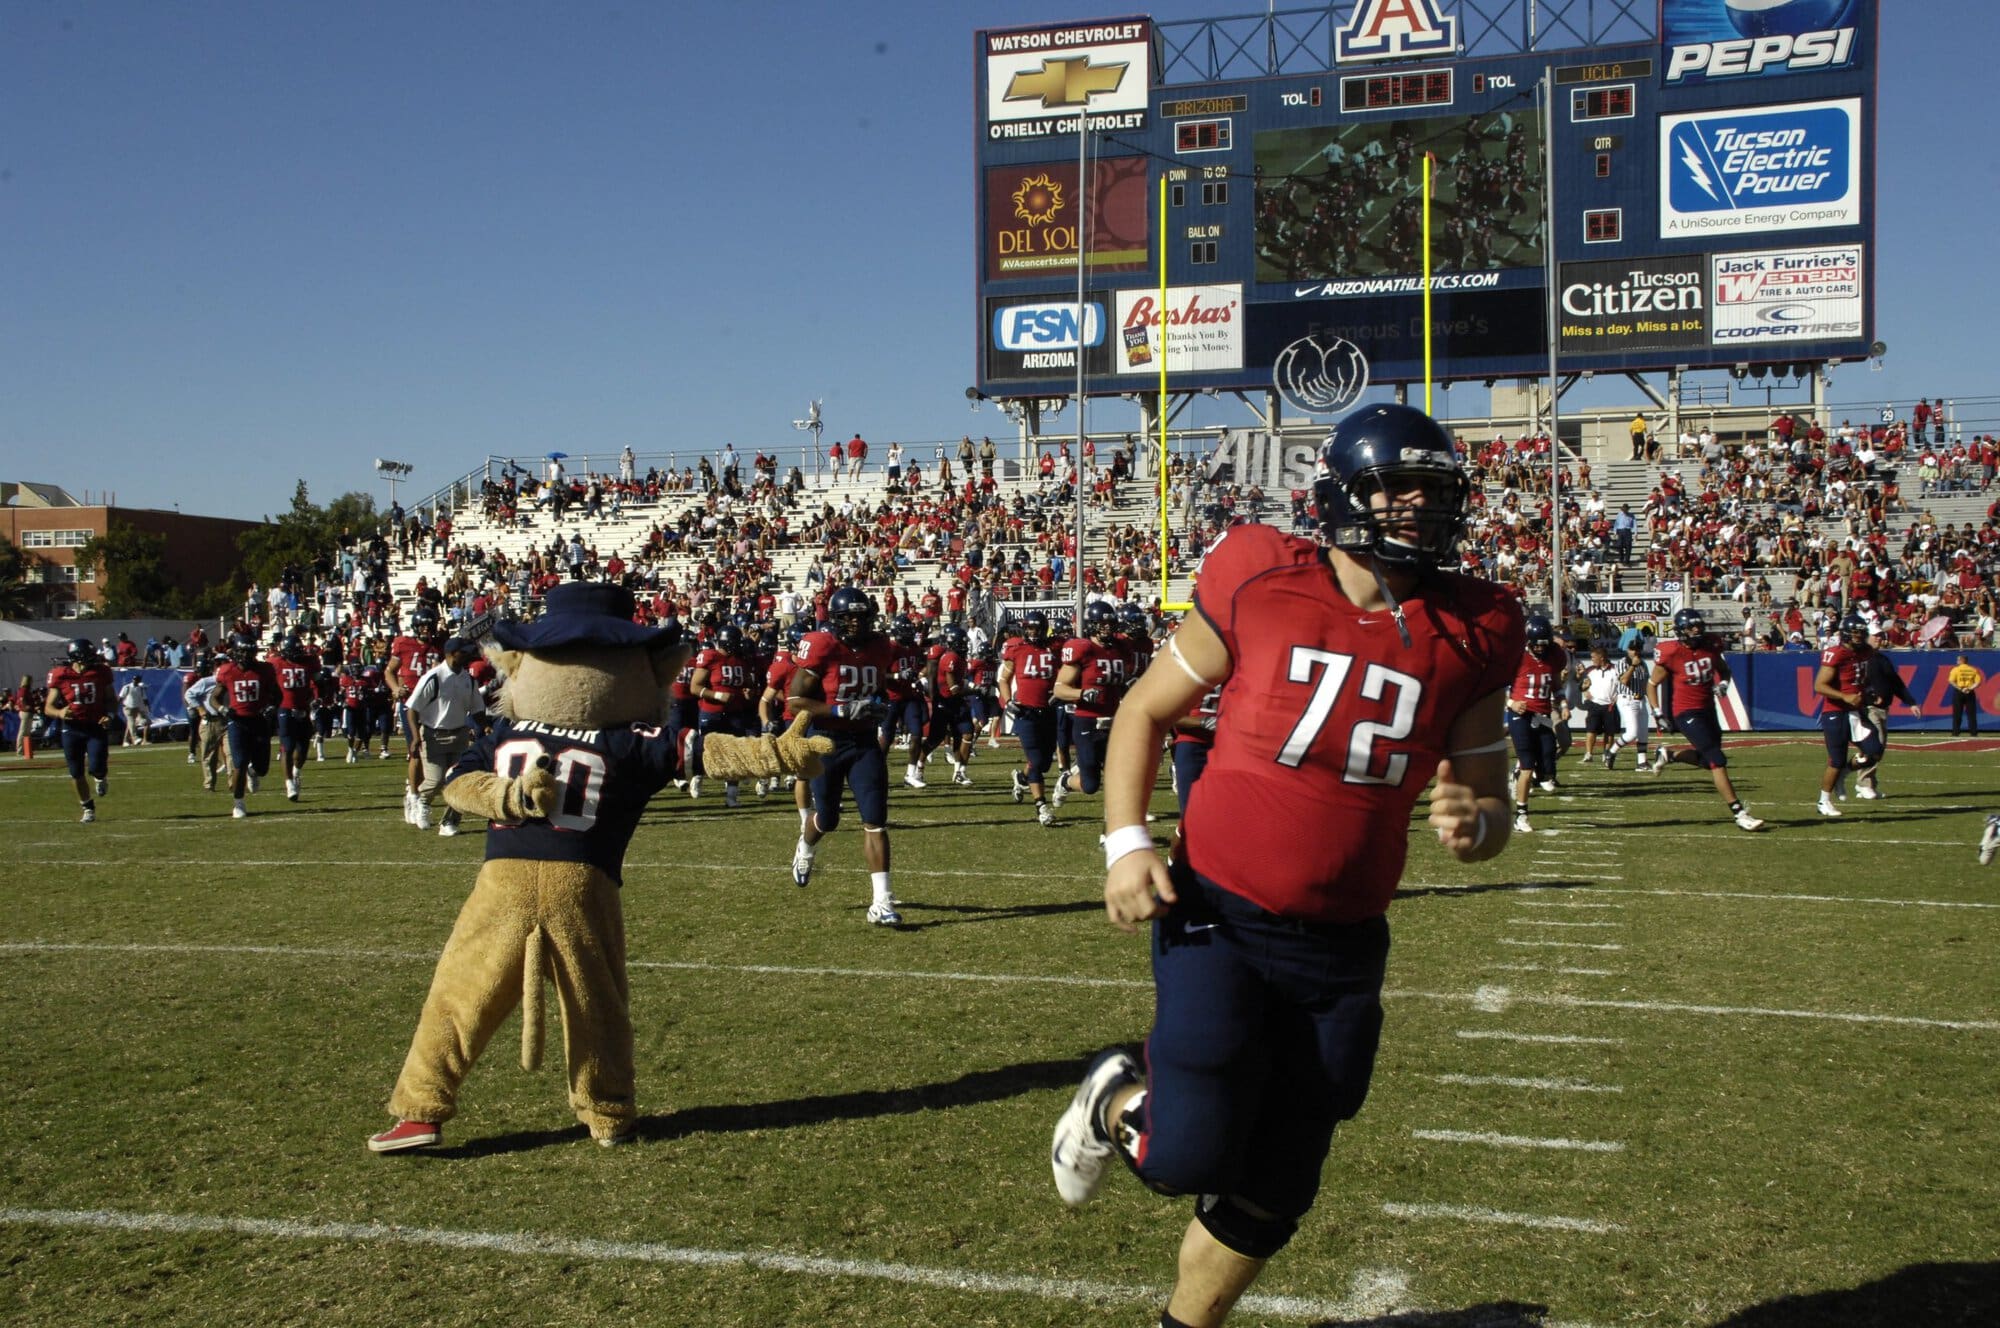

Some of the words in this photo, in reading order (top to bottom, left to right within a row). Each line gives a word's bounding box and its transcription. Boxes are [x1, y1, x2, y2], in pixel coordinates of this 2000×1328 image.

[991, 33, 1050, 50] WATSON
[1054, 24, 1142, 45] CHEVROLET
[1666, 27, 1855, 82] PEPSI
[1487, 75, 1516, 88] TOL
[1582, 64, 1622, 82] UCLA
[1175, 98, 1233, 116] ARIZONA
[1281, 94, 1308, 106] TOL
[990, 120, 1055, 138] O'RIELLY
[1594, 137, 1612, 150] QTR
[1714, 127, 1806, 153] Tucson
[1722, 145, 1832, 174] Electric
[1169, 169, 1187, 181] DWN
[1203, 167, 1213, 179] TO
[1215, 166, 1227, 178] GO
[1733, 172, 1831, 196] Power
[1668, 219, 1678, 230] A
[1681, 216, 1741, 230] UniSource
[1744, 213, 1786, 226] Energy
[1789, 208, 1848, 223] Company
[999, 229, 1035, 254] DEL
[1043, 226, 1079, 251] SOL
[1188, 226, 1207, 238] BALL
[1208, 225, 1220, 237] ON
[1003, 256, 1079, 269] AVAconcerts.com
[1719, 259, 1765, 274] Jack
[1773, 253, 1856, 269] Furrier's
[1628, 271, 1700, 287] Tucson
[1562, 280, 1703, 316] Citizen
[1760, 288, 1782, 296] TIRE
[1785, 287, 1791, 295] &
[1795, 286, 1823, 294] AUTO
[1826, 284, 1853, 293] CARE
[1123, 295, 1237, 328] Bashas'
[1011, 308, 1088, 344] FSN
[1199, 331, 1215, 340] You
[1217, 330, 1229, 340] By
[1308, 321, 1400, 340] Famous
[1562, 325, 1592, 336] Miss
[1595, 327, 1604, 335] a
[1607, 323, 1632, 336] day.
[1636, 321, 1667, 333] Miss
[1670, 322, 1679, 330] a
[1682, 320, 1703, 330] lot.
[1128, 338, 1145, 347] YOU
[1184, 344, 1199, 352] You
[1201, 342, 1233, 353] Money.
[1022, 351, 1075, 369] ARIZONA
[1882, 410, 1894, 421] 29
[1664, 582, 1680, 591] 29
[1590, 600, 1670, 615] BRUEGGER'S
[1023, 653, 1052, 679] 45
[1823, 651, 1834, 663] 17
[282, 668, 306, 689] 33
[721, 665, 744, 686] 99
[1096, 659, 1124, 685] 39
[1684, 657, 1713, 686] 92
[234, 680, 259, 702] 53
[835, 665, 878, 701] 28
[1524, 673, 1552, 699] 16
[71, 682, 96, 705] 13
[1273, 644, 1423, 787] 72
